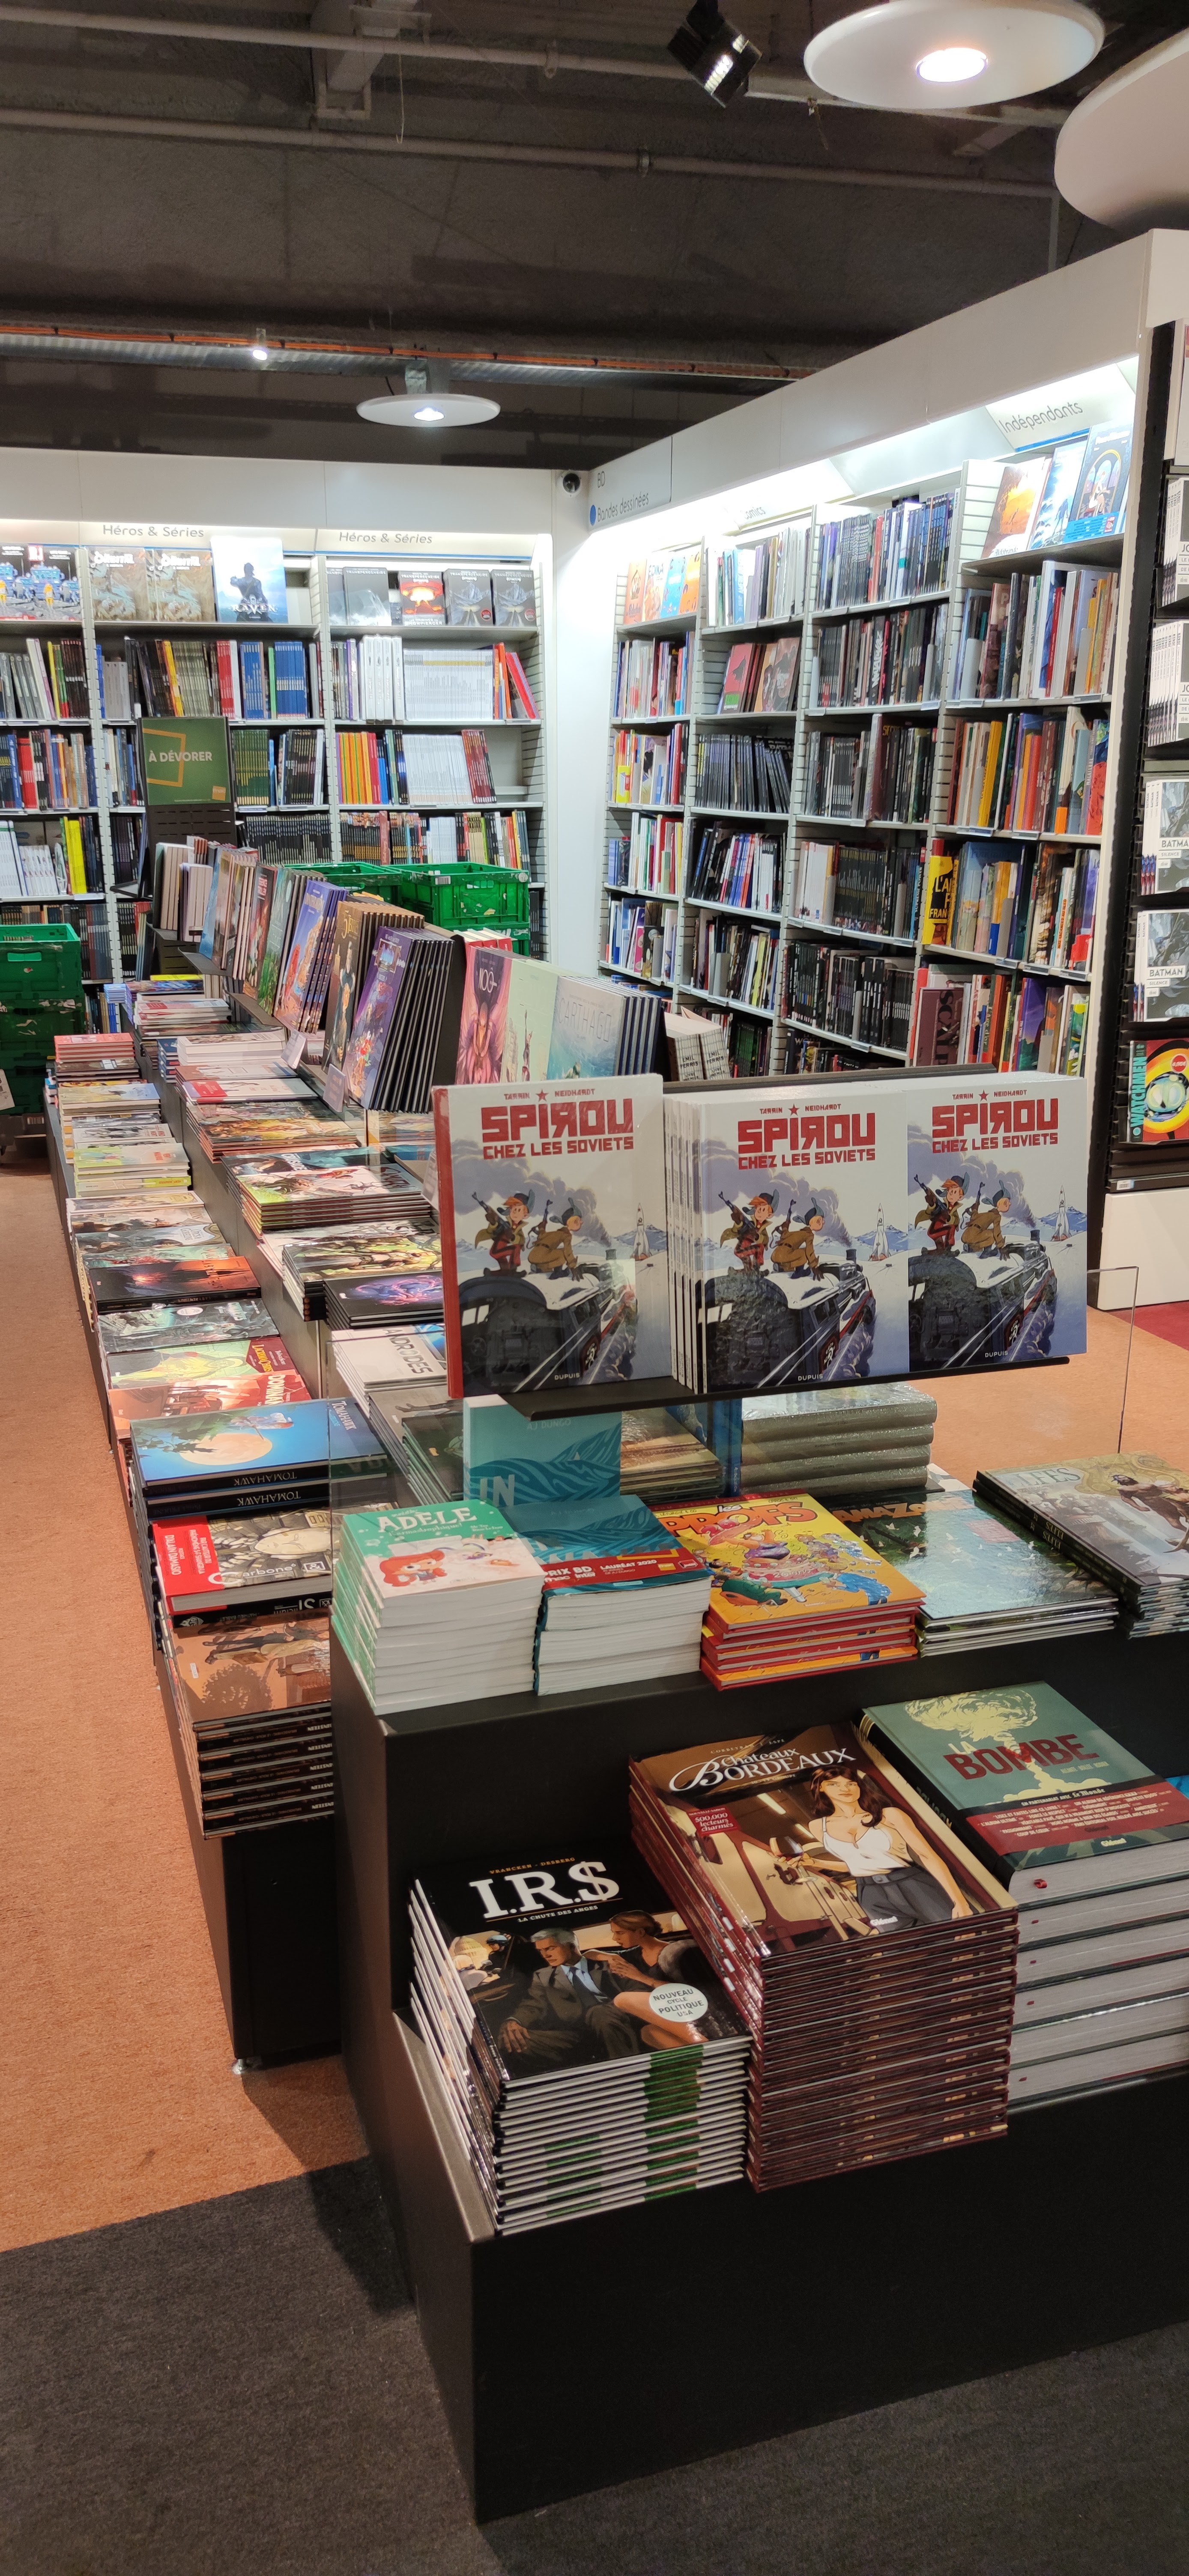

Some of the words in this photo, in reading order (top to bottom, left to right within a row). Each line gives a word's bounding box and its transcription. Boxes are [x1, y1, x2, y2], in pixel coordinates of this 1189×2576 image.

[998, 401, 1083, 434] Indépendants
[597, 471, 606, 488] BD
[597, 504, 618, 523] Bandes
[619, 491, 649, 513] dessinées
[103, 524, 143, 537] Héros
[148, 526, 158, 537] &
[163, 526, 204, 538] Séries
[339, 532, 376, 543] Héros
[381, 534, 390, 543] &
[394, 534, 433, 544] Séries
[149, 750, 157, 763] À
[160, 749, 213, 762] DÉVORER
[1161, 839, 1189, 848] BATMA
[1149, 966, 1184, 978] BATMAN
[558, 996, 612, 1043] CARTHAGO
[680, 1061, 699, 1069] FERRIS
[707, 1056, 724, 1064] FERRIS
[1131, 1056, 1147, 1128] WATCHMEN
[483, 1145, 526, 1160] CHEZ
[530, 1141, 563, 1157] LES
[567, 1136, 634, 1154] SOVIETS
[932, 1138, 968, 1154] CHEZ
[972, 1136, 999, 1151] LES
[1003, 1132, 1058, 1148] SOVIETS
[738, 1156, 777, 1170] CHEZ
[781, 1153, 811, 1167] LES
[815, 1148, 876, 1164] SOVIETS
[984, 1350, 1009, 1358] DUPUIS
[554, 1372, 580, 1381] DUPUIS
[798, 1373, 824, 1381] DUPUIS
[332, 1400, 357, 1431] TOMAHAWK
[233, 1472, 297, 1486] TOMAHAWK
[479, 1474, 515, 1506] IN
[237, 1491, 301, 1506] TOMAHAWK
[717, 1504, 743, 1513] les
[658, 1501, 818, 1537] PROFS
[168, 1552, 182, 1576] DAMASIO
[600, 1562, 636, 1570] LAURÉAT
[947, 1740, 982, 1756] LA
[721, 1747, 800, 1768] Châteaux
[941, 1733, 1101, 1781] BOMBE
[668, 1747, 857, 1792] BORDEAUX
[1028, 1796, 1059, 1805] PARTENARIAT
[1081, 1788, 1105, 1797] Monde
[699, 1817, 729, 1828] lecteurs
[701, 1822, 734, 1833] charmés
[1100, 1837, 1126, 1848] Glénat
[489, 1863, 532, 1875] VRANCKEN
[540, 1857, 576, 1866] DESBERG
[469, 1860, 620, 1920] I.R.$
[529, 1912, 556, 1921] CHUTE
[573, 1905, 598, 1913] ANGES
[869, 1915, 898, 1927] Glénat
[652, 1988, 694, 2001] NOUVEAU
[667, 1996, 688, 2004] CYCLE
[658, 2000, 705, 2014] POLITIQUE
